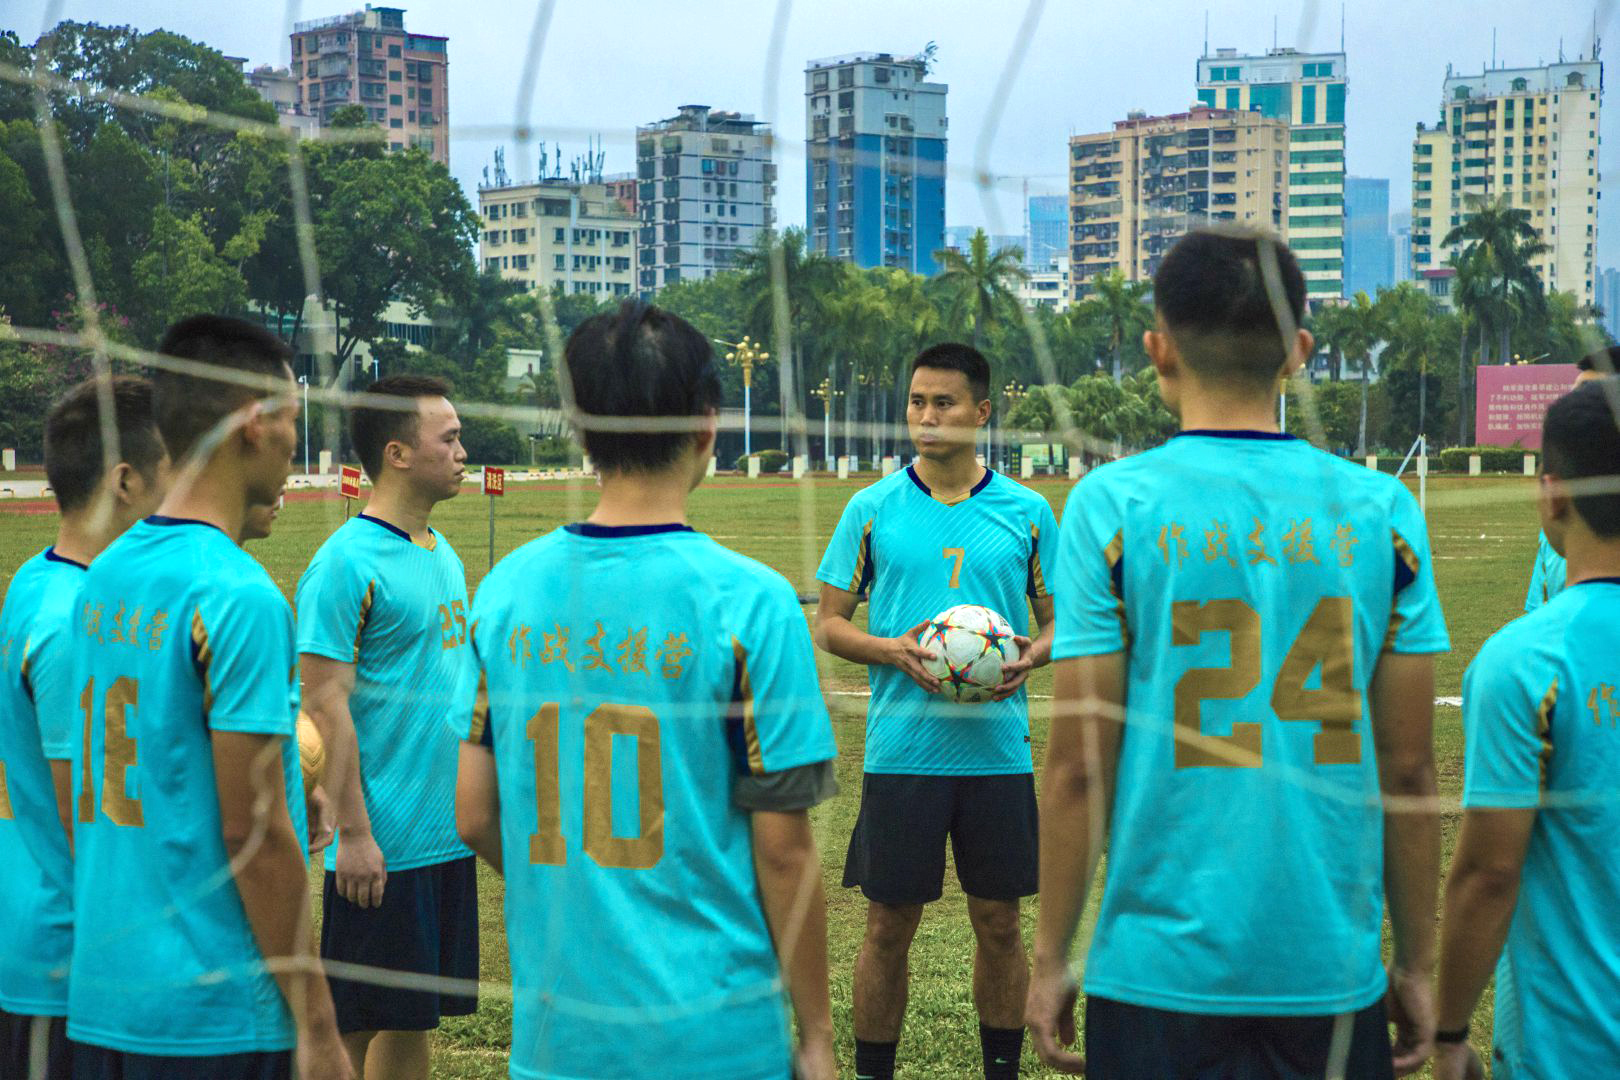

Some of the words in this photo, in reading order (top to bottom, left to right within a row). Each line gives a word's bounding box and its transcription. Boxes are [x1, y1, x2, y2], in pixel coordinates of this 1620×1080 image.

[942, 547, 965, 588] 7
[1157, 516, 1360, 571] 作战支援营
[438, 600, 467, 650] 25
[509, 620, 692, 679] 作战支援营
[1171, 596, 1362, 769] 24
[526, 702, 665, 870] 10
